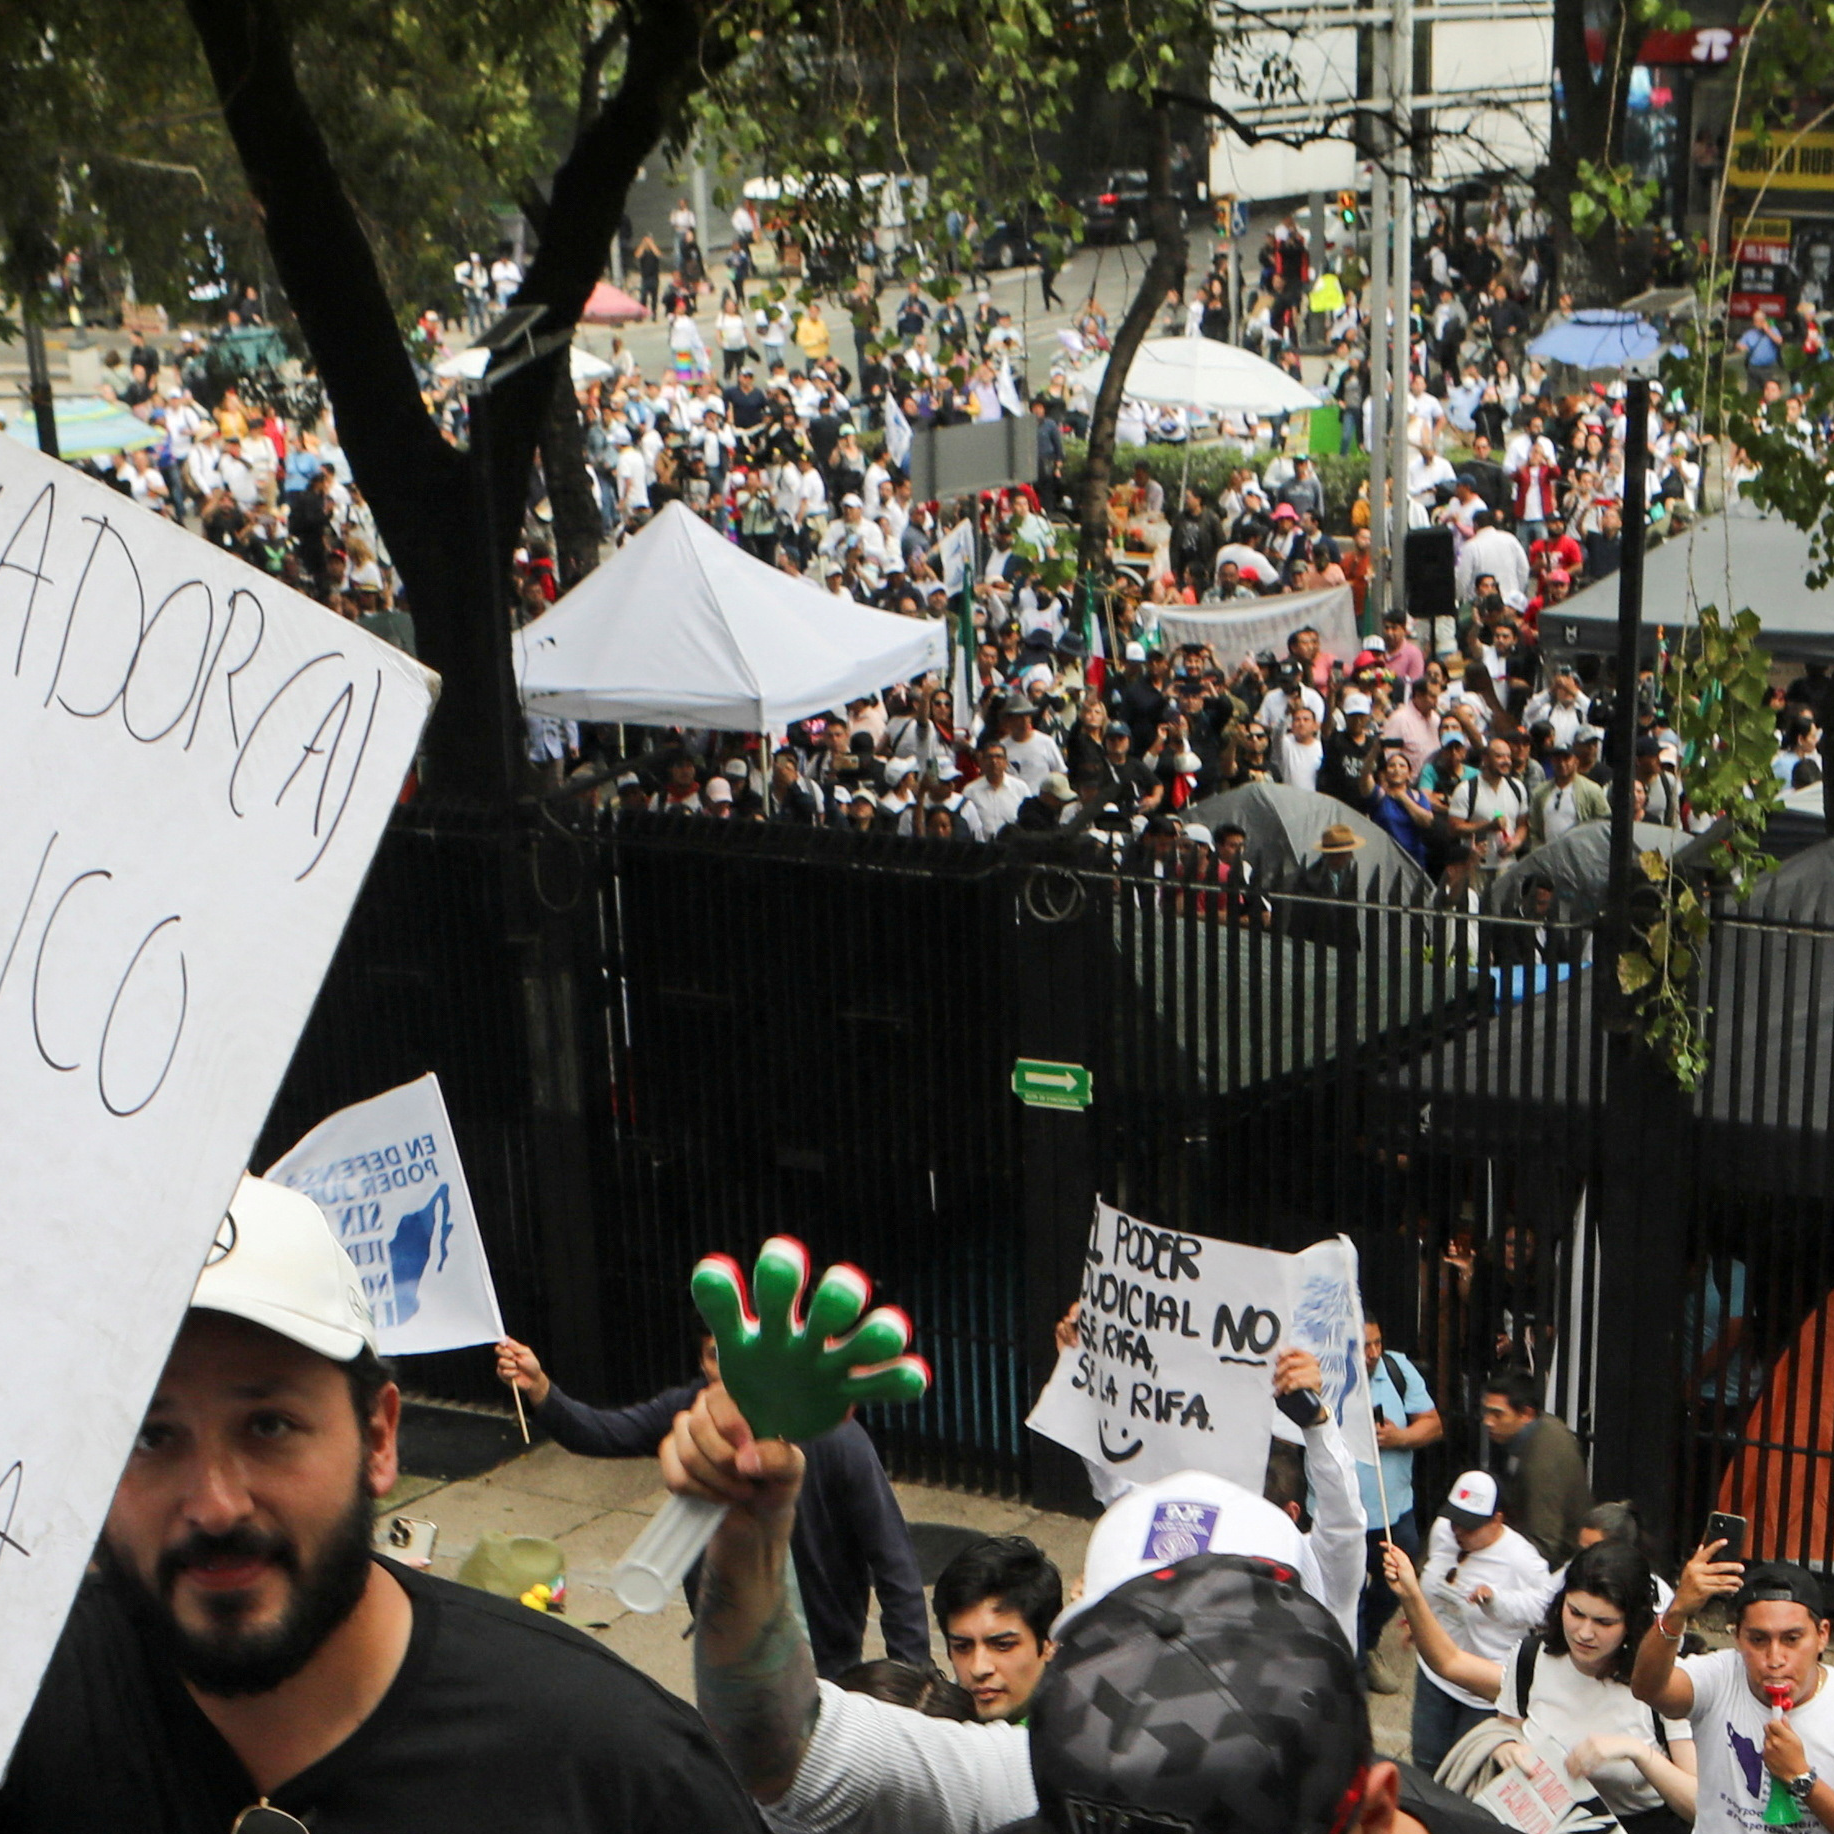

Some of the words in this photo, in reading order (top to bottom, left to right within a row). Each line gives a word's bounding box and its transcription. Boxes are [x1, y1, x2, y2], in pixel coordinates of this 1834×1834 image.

[1114, 1214, 1202, 1282] PODER
[1078, 1309, 1098, 1354] SE
[1081, 1263, 1200, 1338] JUDICIAL
[1212, 1304, 1281, 1354] NO
[1072, 1353, 1095, 1398] SE
[1100, 1372, 1119, 1407] LA
[1130, 1383, 1214, 1432] RIFA.
